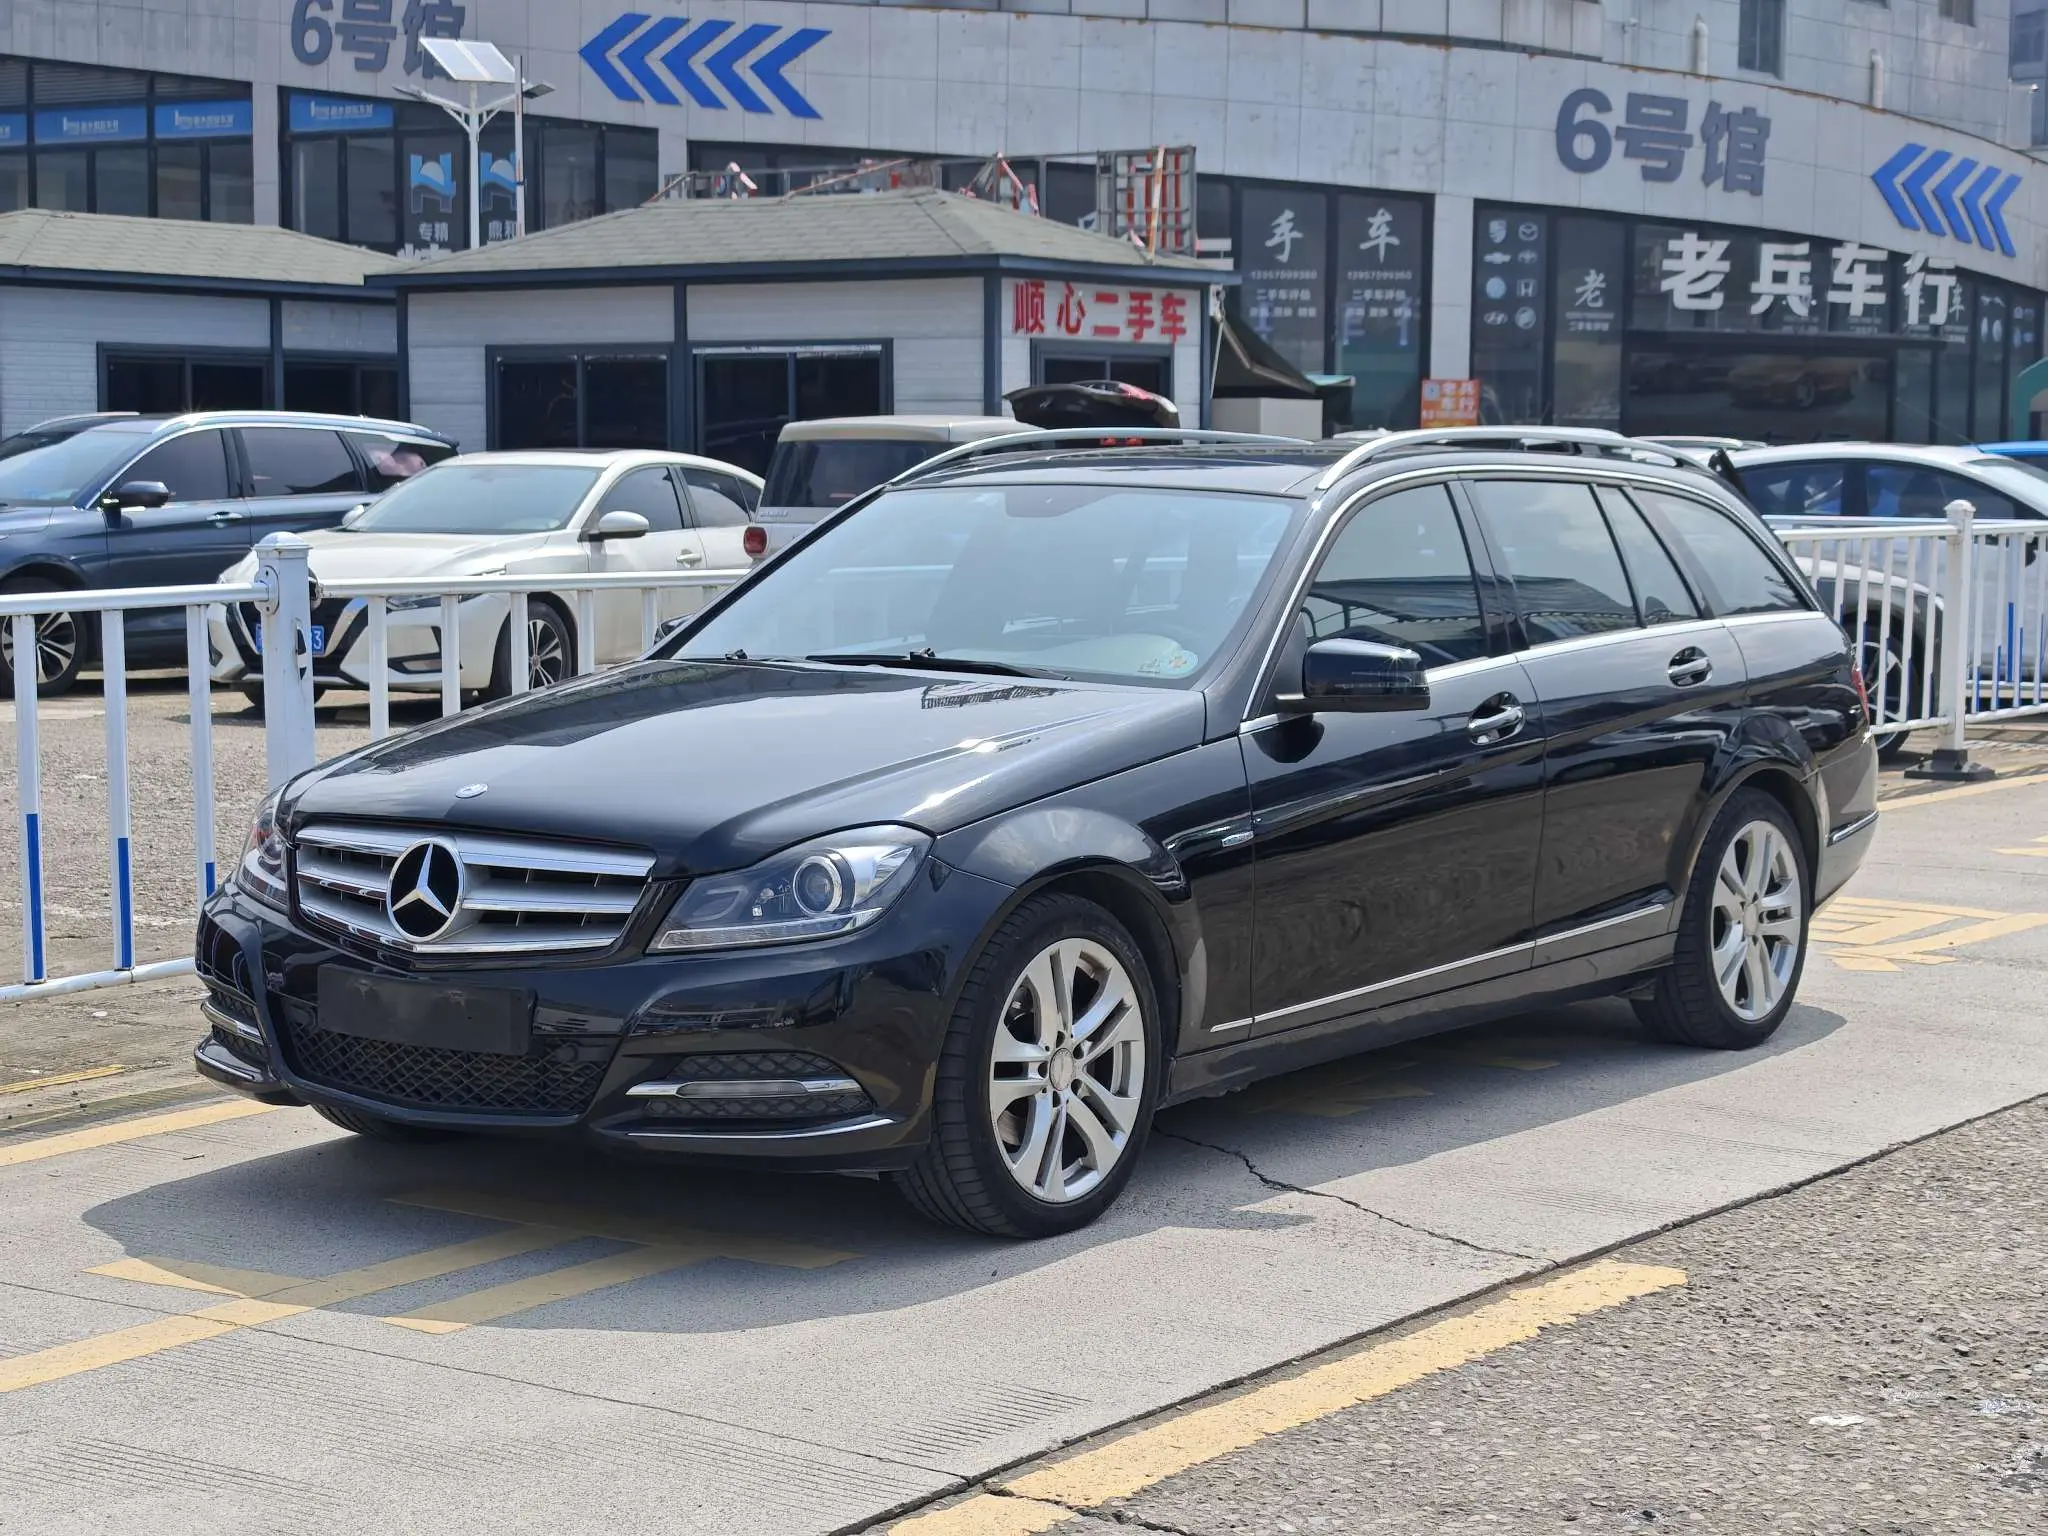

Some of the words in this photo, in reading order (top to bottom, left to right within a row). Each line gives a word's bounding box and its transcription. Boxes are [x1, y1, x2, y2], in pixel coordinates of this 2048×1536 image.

[1555, 87, 1772, 197] 6号馆
[1012, 279, 1188, 344] 顺心二手车
[1575, 268, 1607, 309] 老
[1660, 232, 1958, 326] 老兵车行
